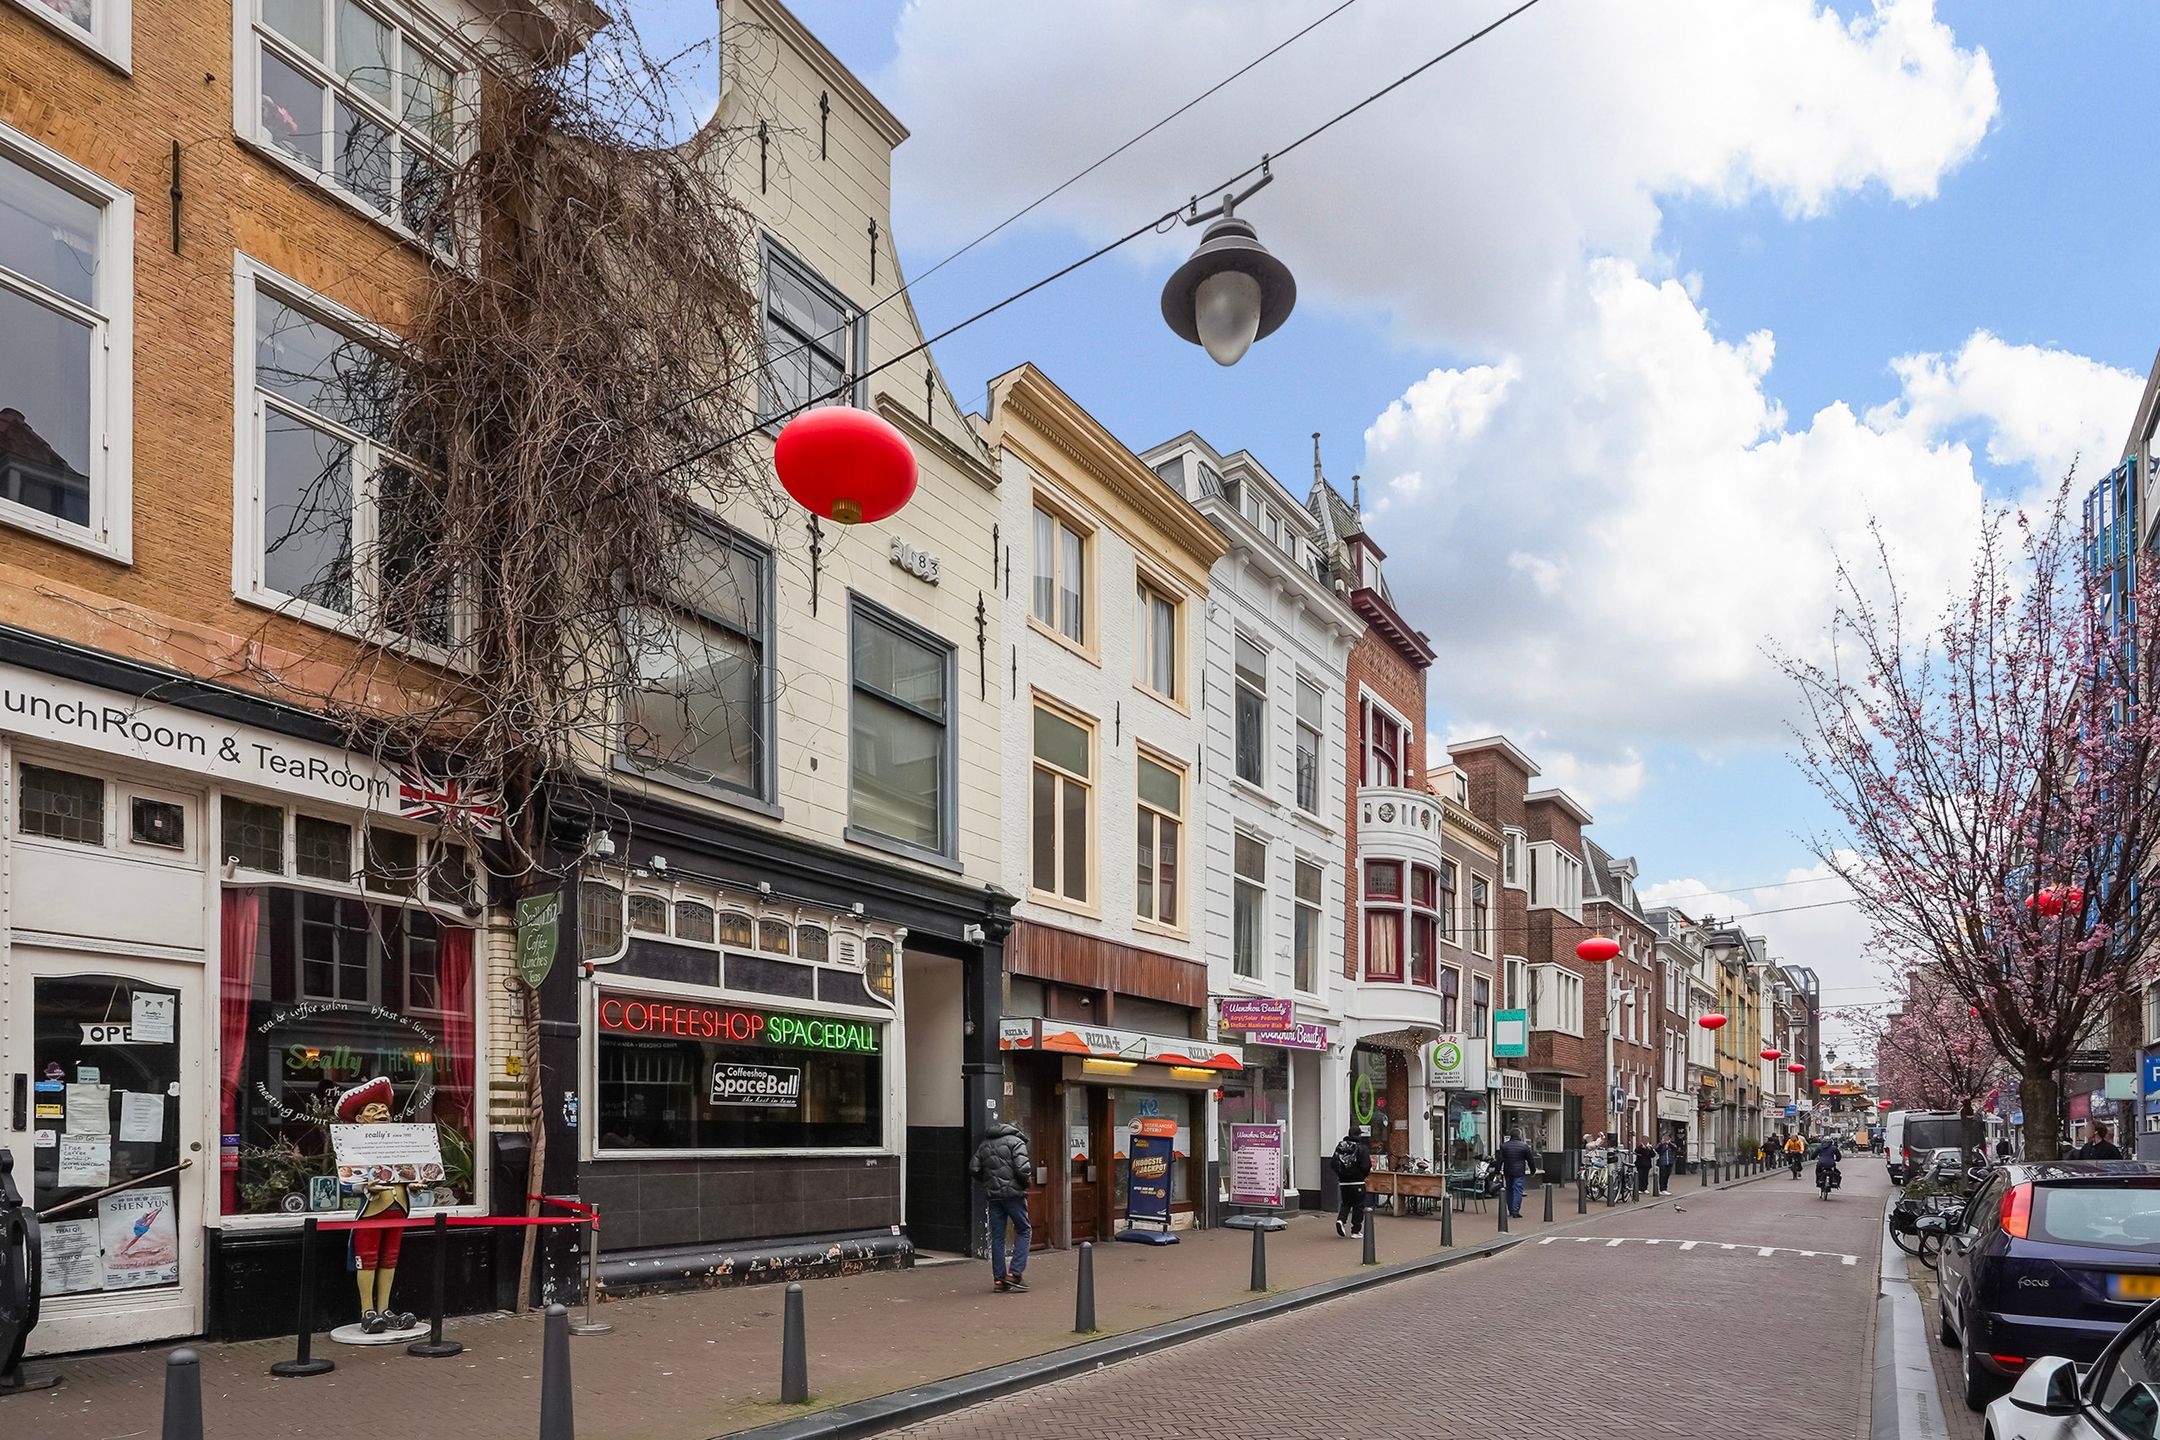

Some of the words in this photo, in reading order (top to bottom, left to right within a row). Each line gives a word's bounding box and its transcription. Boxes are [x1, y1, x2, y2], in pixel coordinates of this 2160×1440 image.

[218, 736, 241, 764] &
[252, 743, 390, 799] TeaRoom
[258, 1019, 275, 1034] tea
[320, 1000, 349, 1012] salon
[1229, 1002, 1260, 1013] Wenzhou
[1261, 1003, 1286, 1016] Beauty
[90, 1026, 132, 1042] OPE
[411, 1021, 436, 1044] lunch
[600, 998, 765, 1041] COFFEESHOP
[767, 1015, 879, 1051] SPACEBALL
[1296, 1024, 1323, 1049] Beauty
[286, 1043, 363, 1078] Scally
[714, 1071, 798, 1098] SpaceBall
[727, 1067, 768, 1080] Coffeeshop
[256, 1080, 293, 1118] meeting
[291, 1112, 328, 1126] point
[418, 1086, 437, 1110] cakes
[1136, 1098, 1158, 1116] K2
[364, 1130, 390, 1140] scally's
[1139, 1163, 1167, 1174] JACKPOT
[110, 1201, 144, 1212] SHEN
[147, 1199, 169, 1208] YUN
